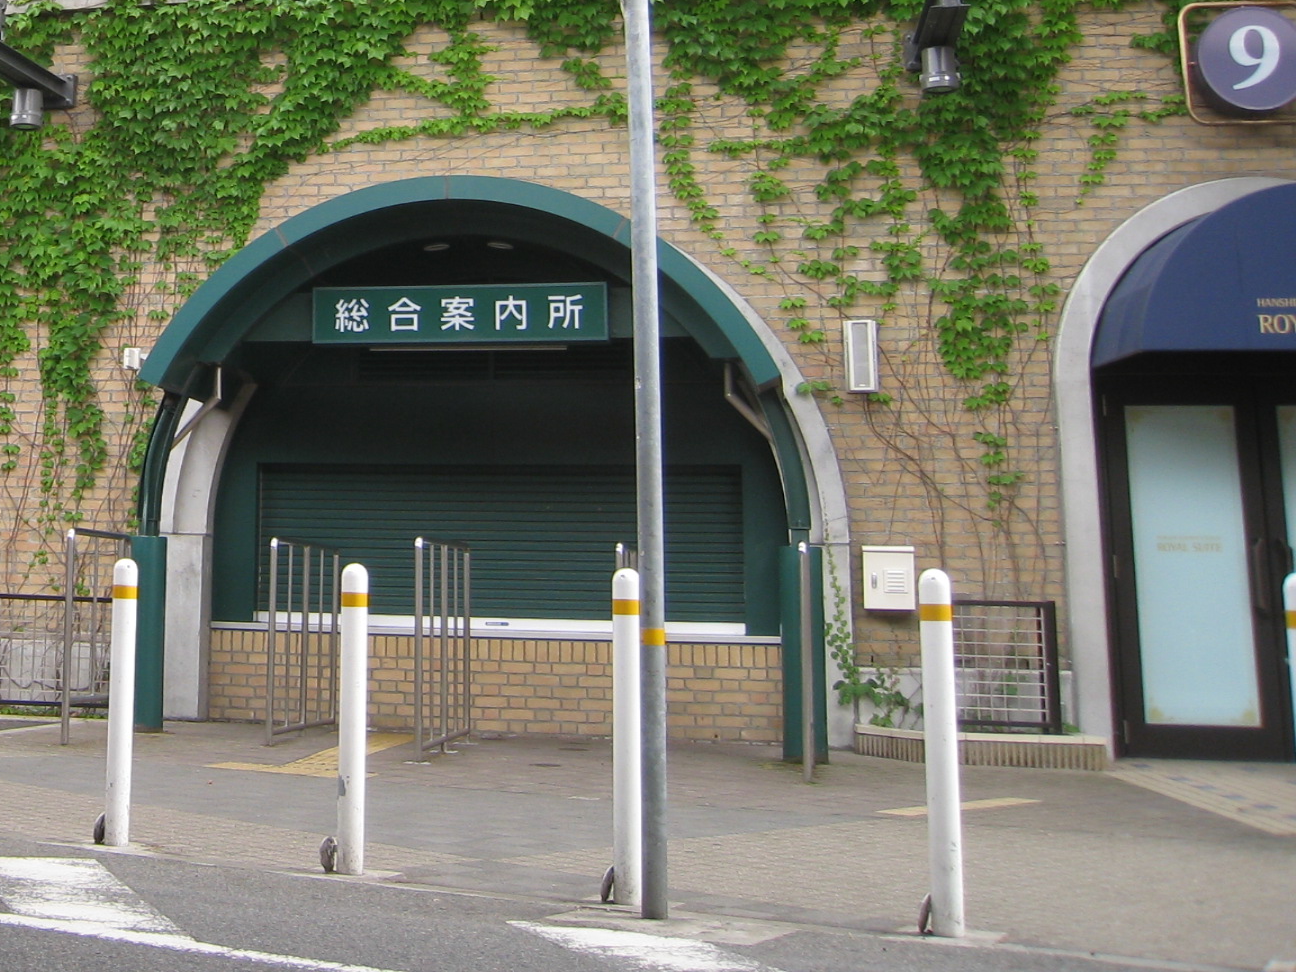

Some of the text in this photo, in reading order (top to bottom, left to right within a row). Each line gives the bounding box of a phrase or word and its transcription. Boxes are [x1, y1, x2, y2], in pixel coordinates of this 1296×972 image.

[1229, 25, 1280, 90] 9
[334, 294, 584, 332] 総合案内所
